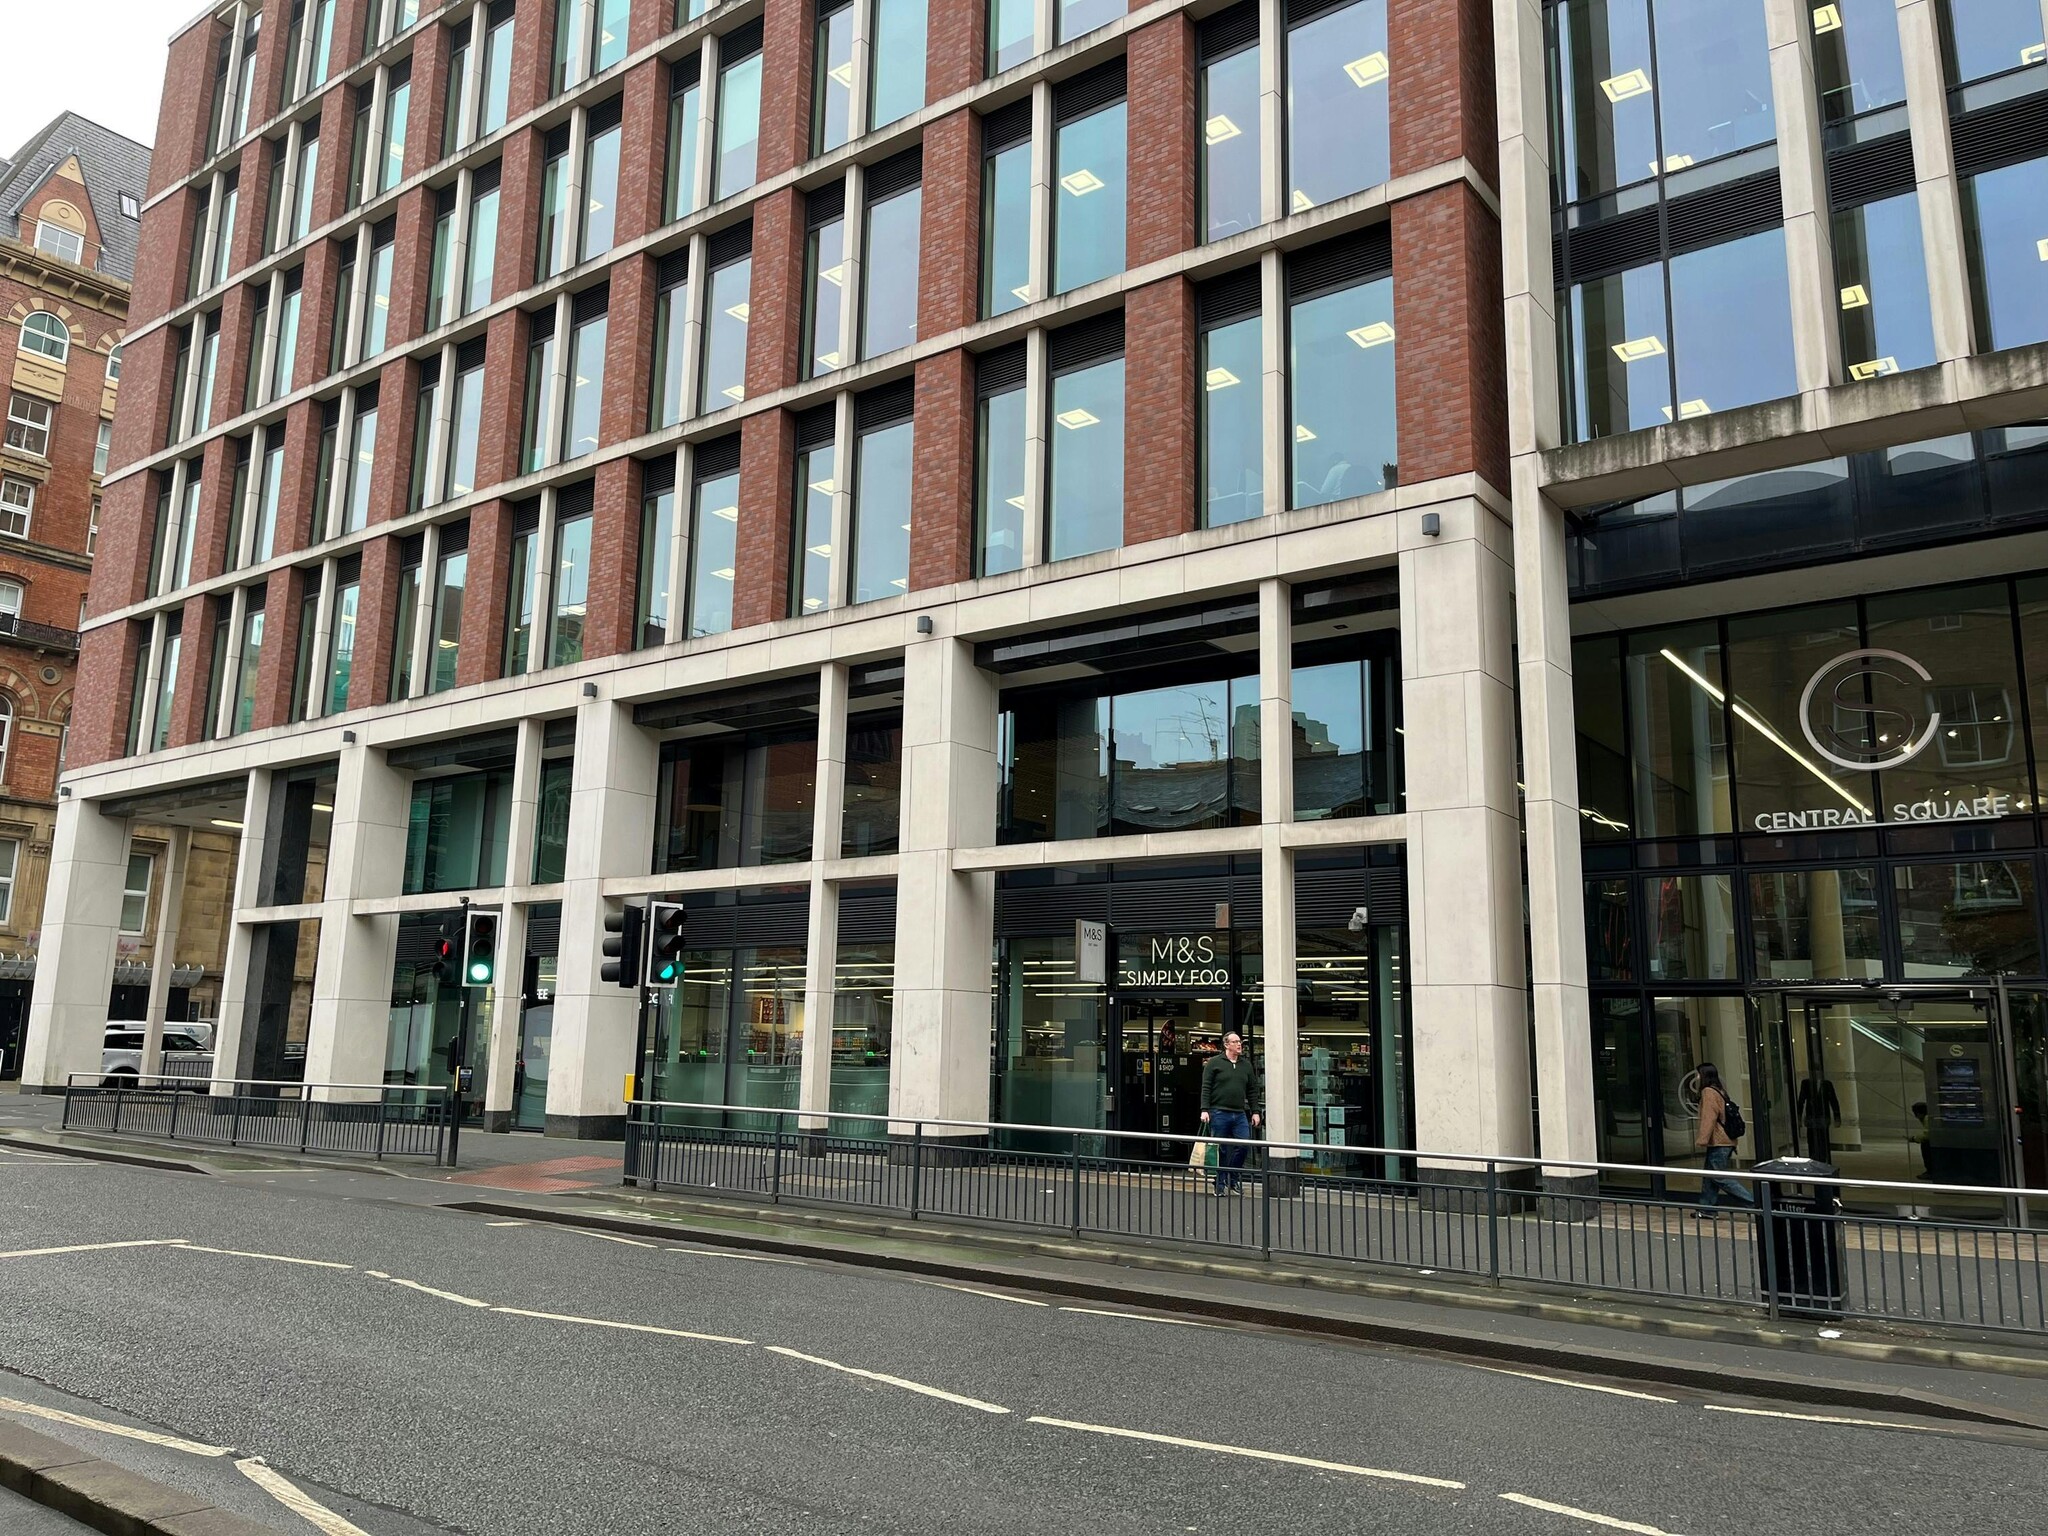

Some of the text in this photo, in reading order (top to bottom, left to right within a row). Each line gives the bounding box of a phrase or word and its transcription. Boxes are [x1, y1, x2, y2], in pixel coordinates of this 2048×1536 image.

[1754, 796, 2009, 832] CENTRAL SQUARE
[1083, 927, 1102, 941] M&S
[1152, 935, 1214, 964] M&S
[1126, 969, 1229, 986] SIMPLY FOO
[1779, 1203, 1806, 1213] Litter
